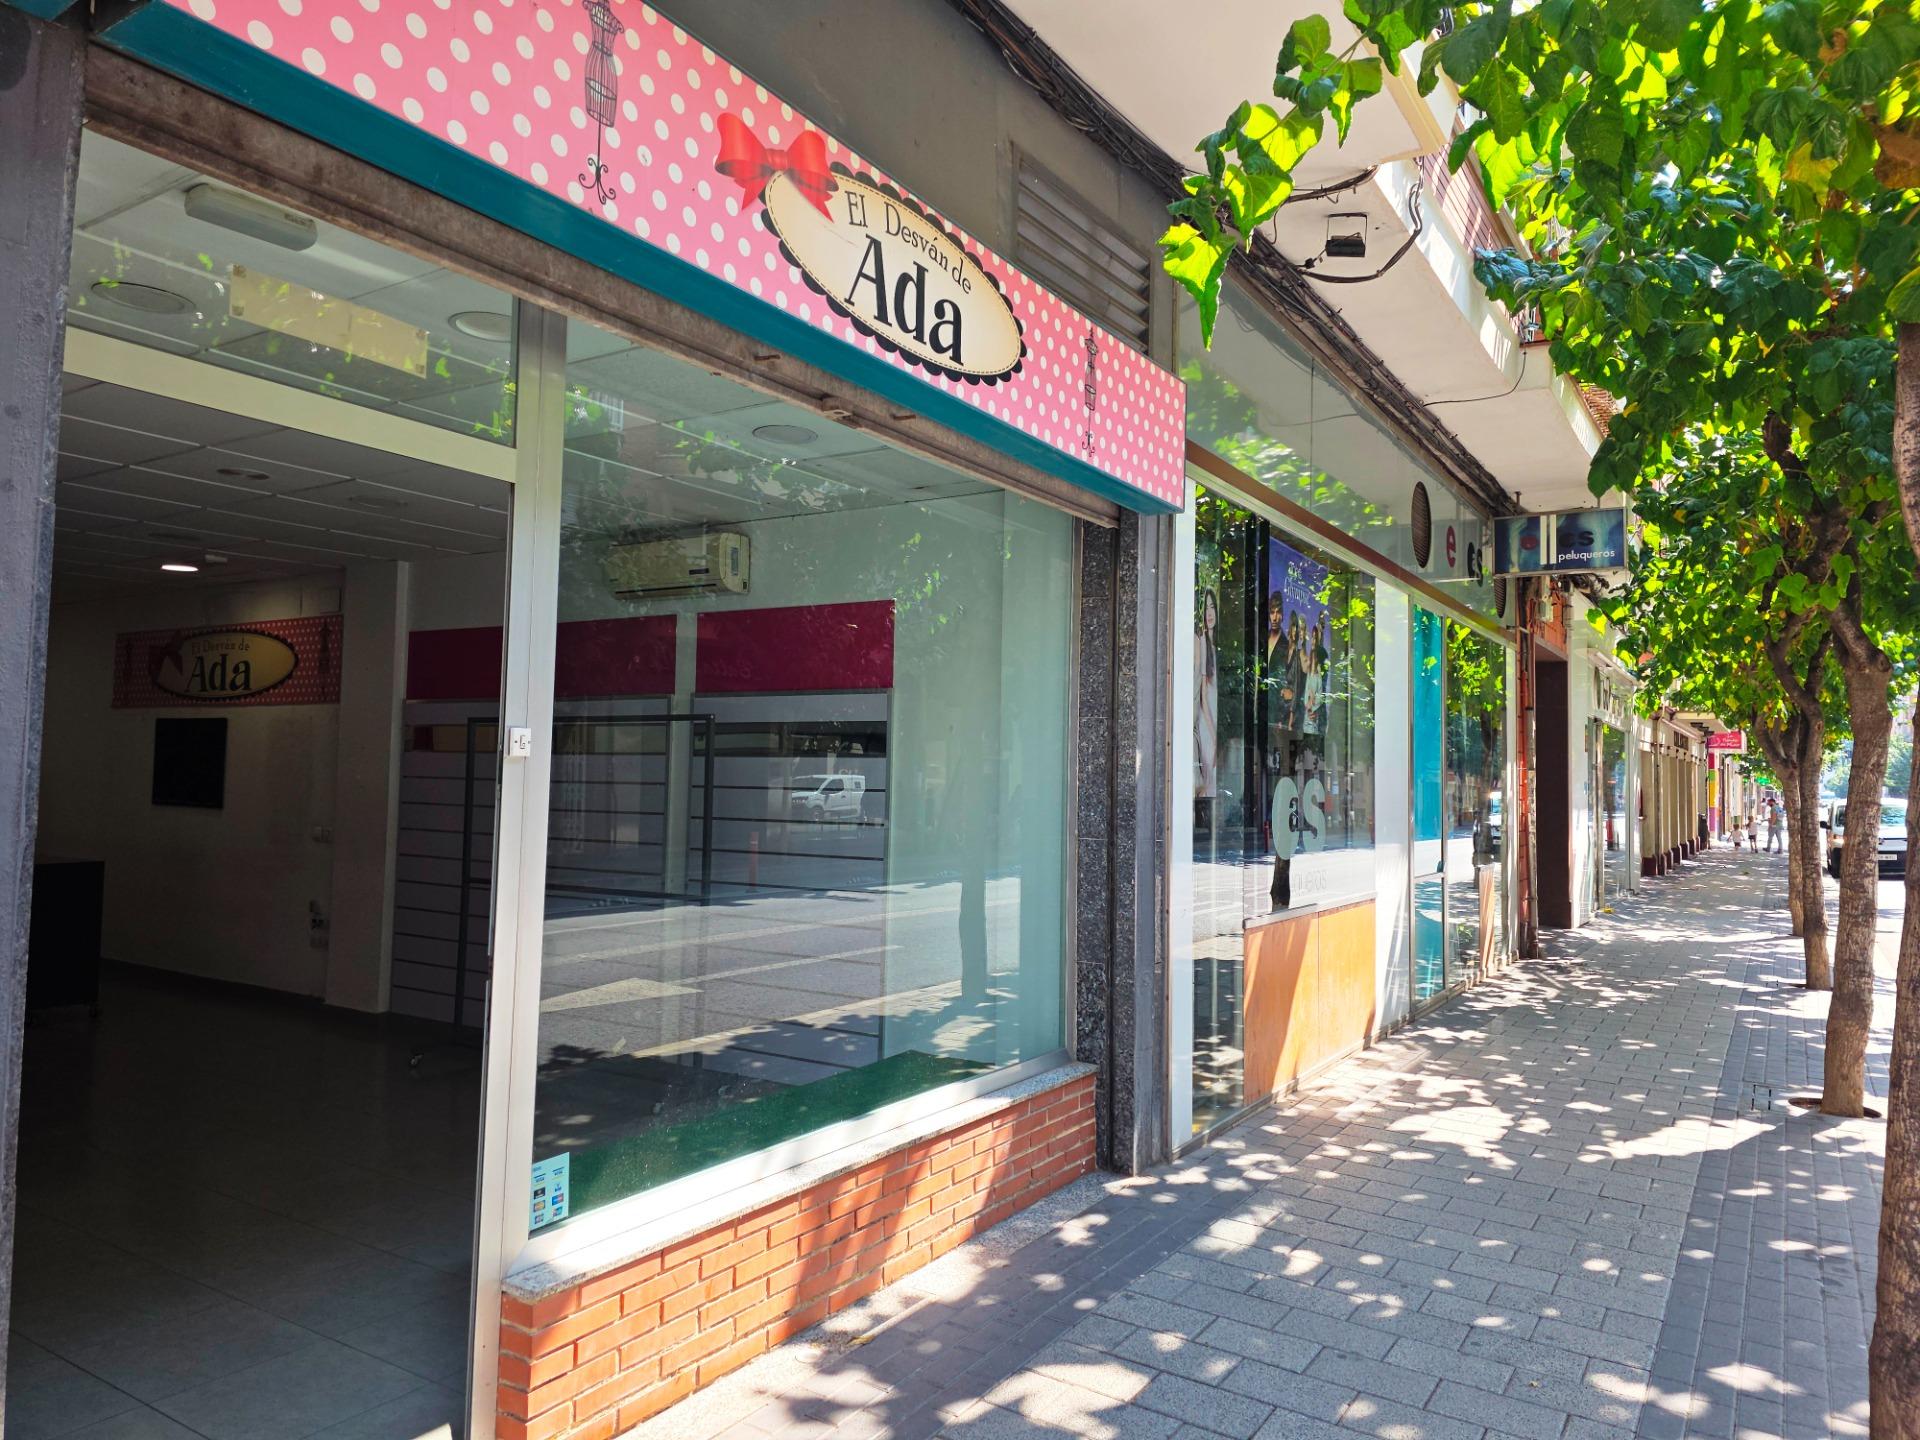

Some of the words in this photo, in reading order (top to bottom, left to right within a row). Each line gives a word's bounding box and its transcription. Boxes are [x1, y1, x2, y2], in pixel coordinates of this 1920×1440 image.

[844, 190, 869, 229] El
[883, 201, 949, 274] Desván
[951, 258, 972, 295] de
[844, 233, 965, 367] Ada
[1558, 549, 1616, 564] peluqueros
[186, 653, 252, 692] Ada
